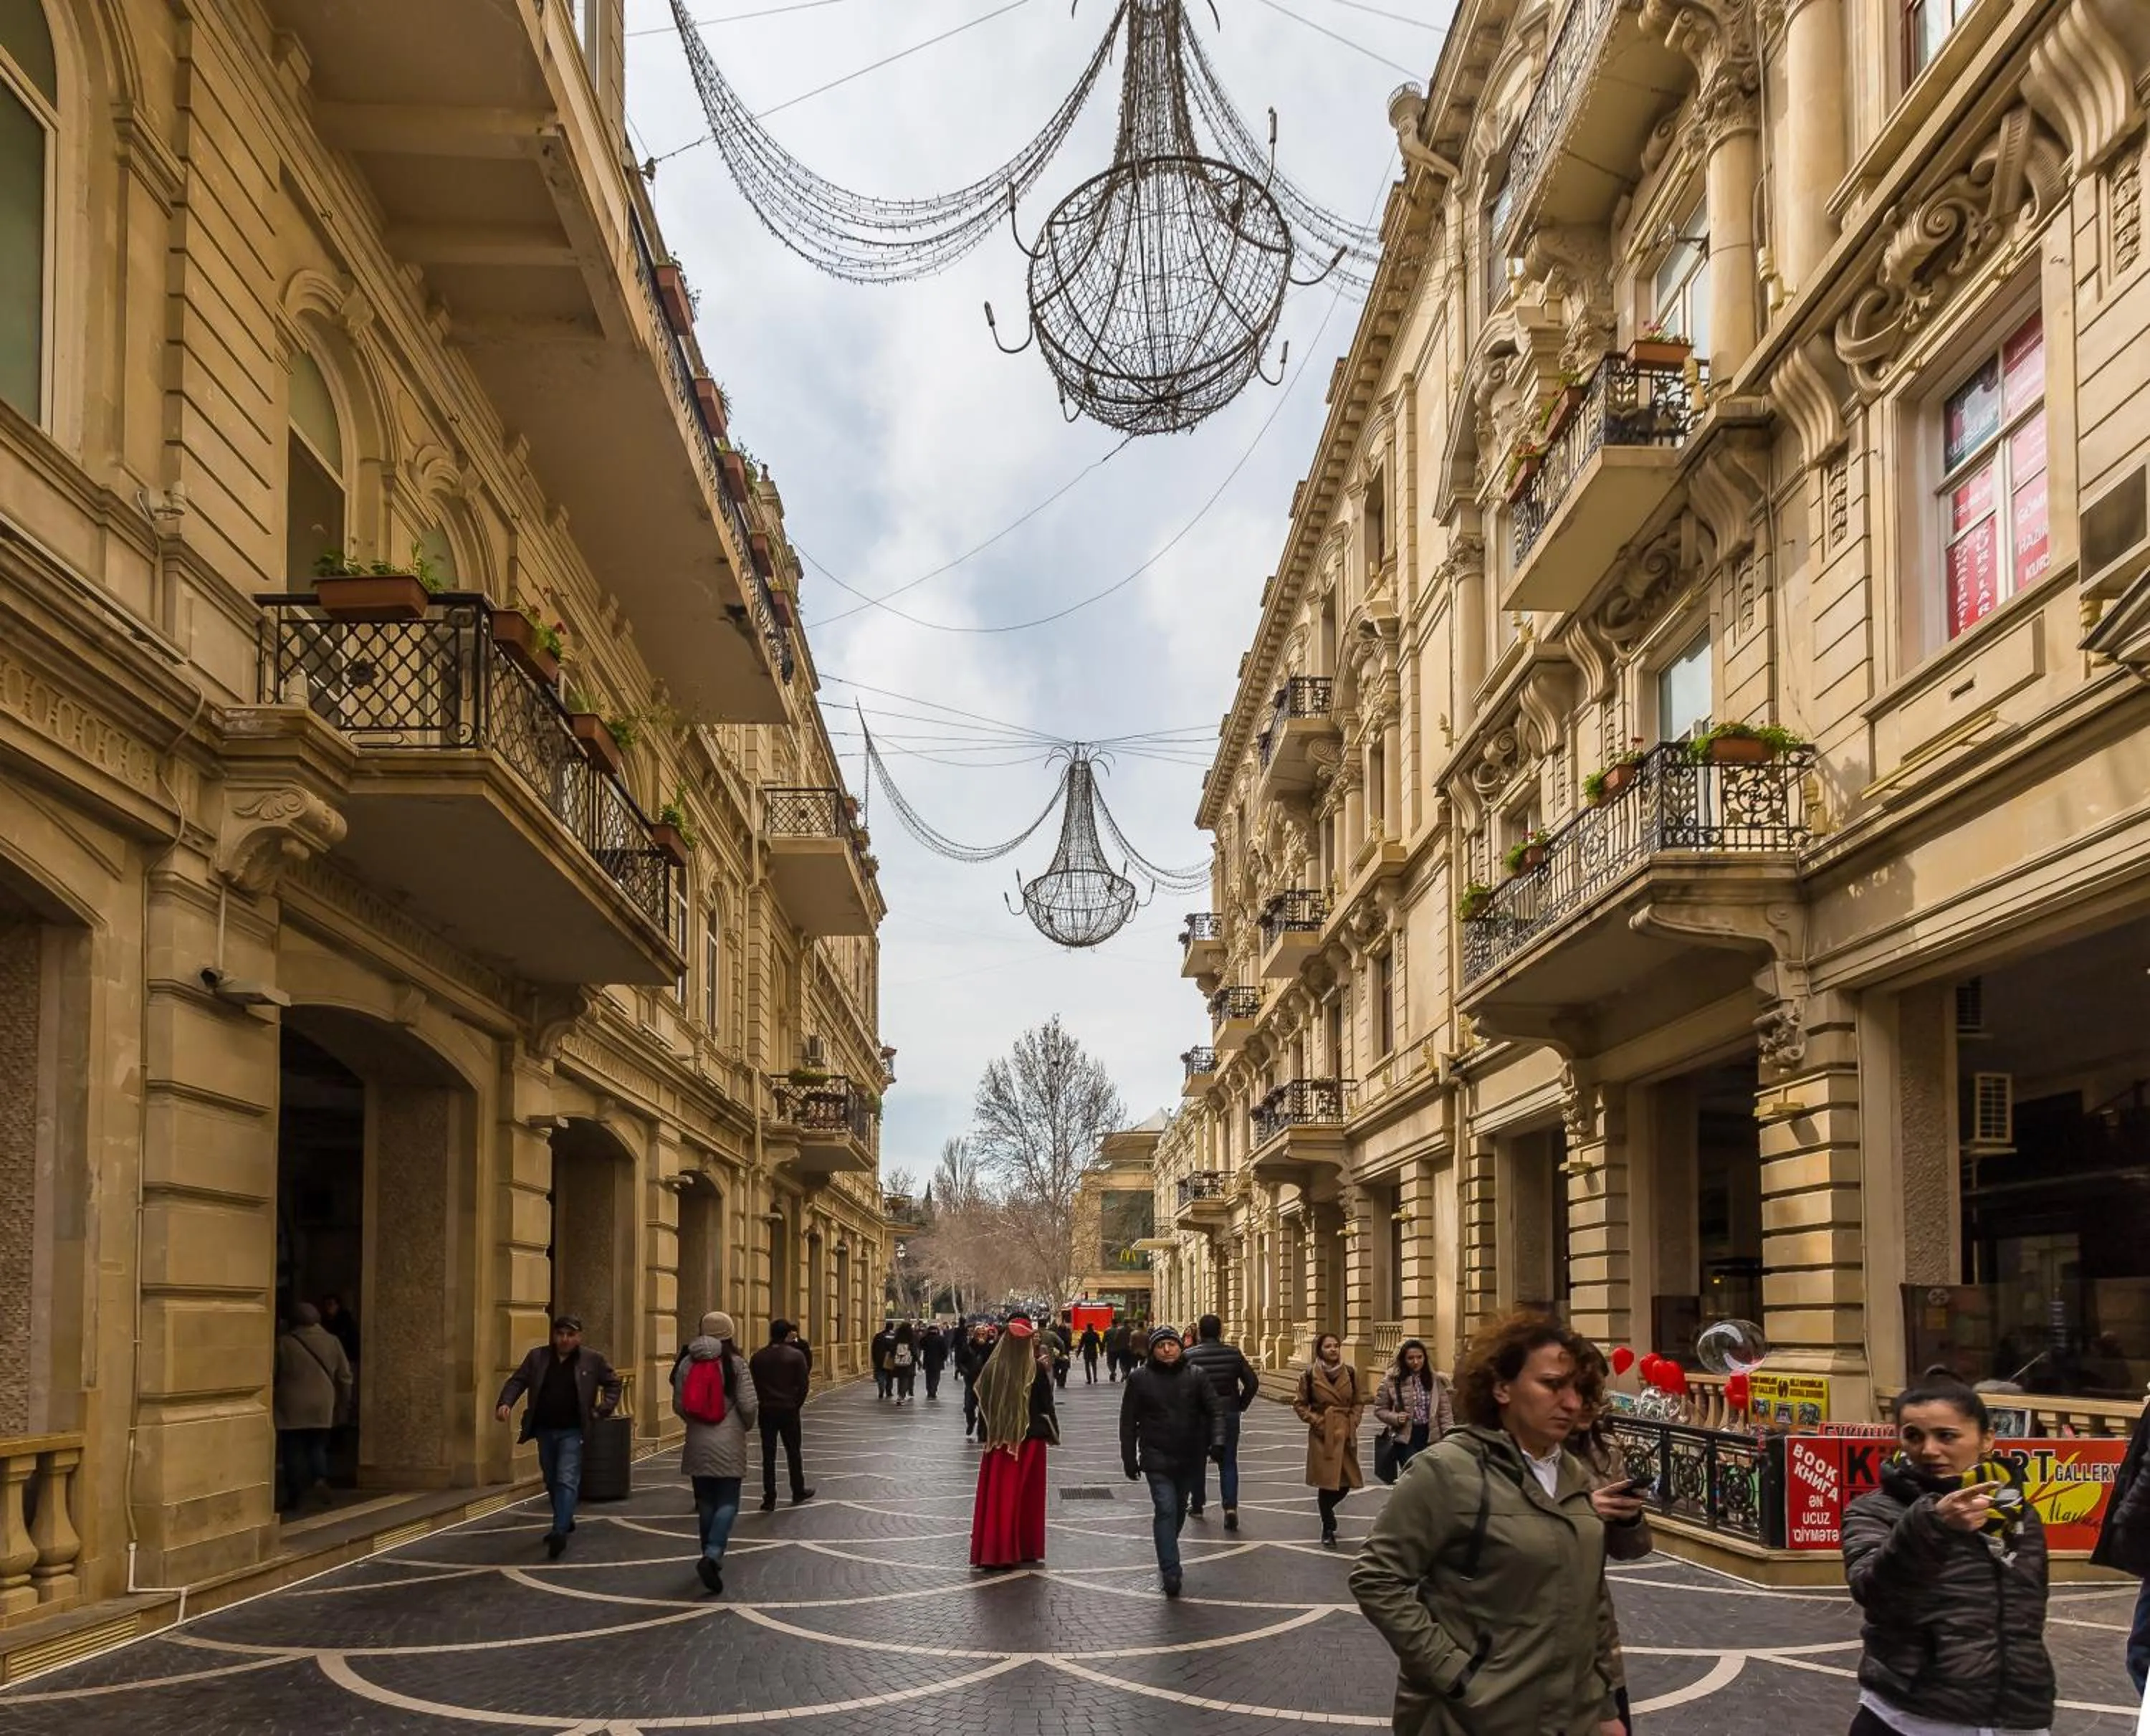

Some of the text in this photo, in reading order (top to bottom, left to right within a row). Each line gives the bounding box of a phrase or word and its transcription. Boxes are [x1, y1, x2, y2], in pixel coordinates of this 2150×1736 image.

[1792, 1443, 1838, 1482] BOOK
[1992, 1448, 2121, 1484] RT GALLERY
[1794, 1462, 1838, 1502] КНИГА
[1802, 1512, 1831, 1525] UCUZ
